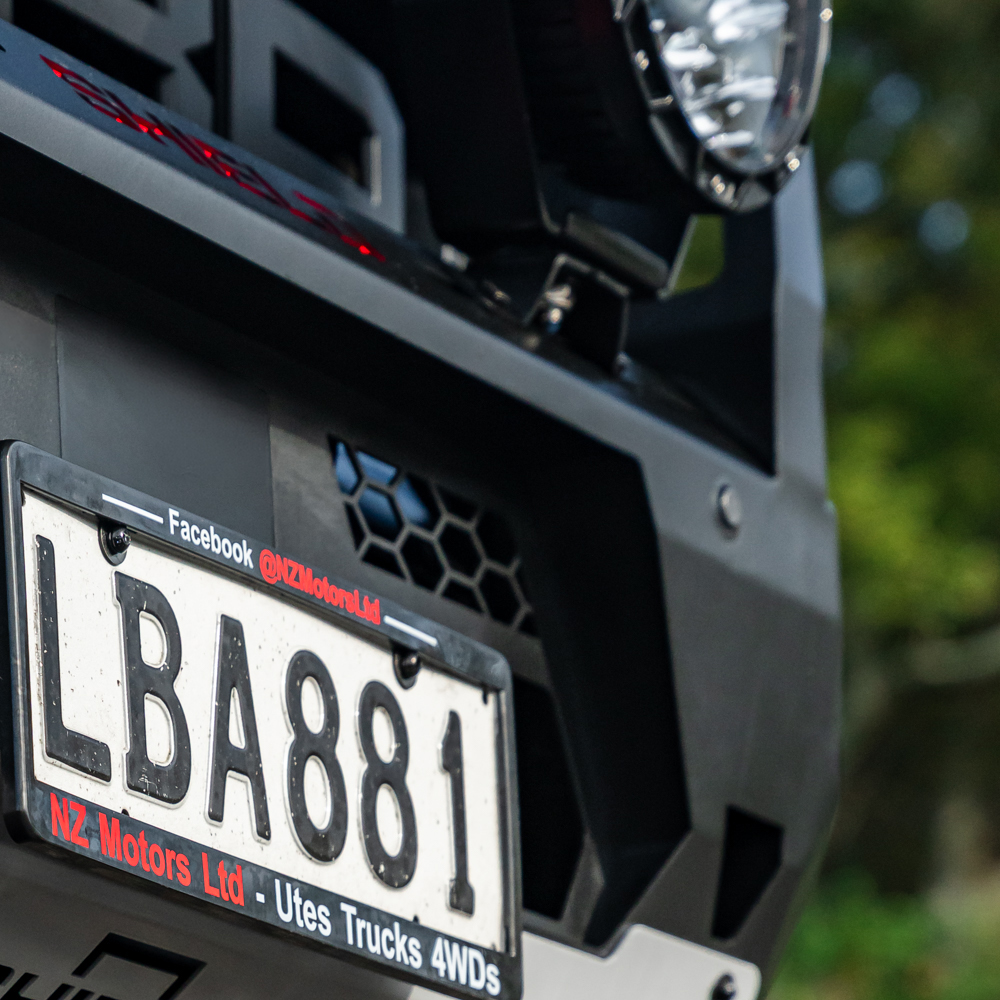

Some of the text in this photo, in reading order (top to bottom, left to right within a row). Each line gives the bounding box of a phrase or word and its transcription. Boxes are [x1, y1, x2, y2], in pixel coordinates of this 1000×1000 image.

[168, 508, 381, 625] Facebook @NZMotorsLtd
[34, 534, 476, 916] LBA881
[50, 793, 90, 849] NZ
[99, 812, 192, 887] Motors
[202, 853, 245, 907] Ltd
[274, 879, 332, 936] Utes
[340, 903, 422, 970] Trucks
[431, 938, 501, 995] 4WDs
